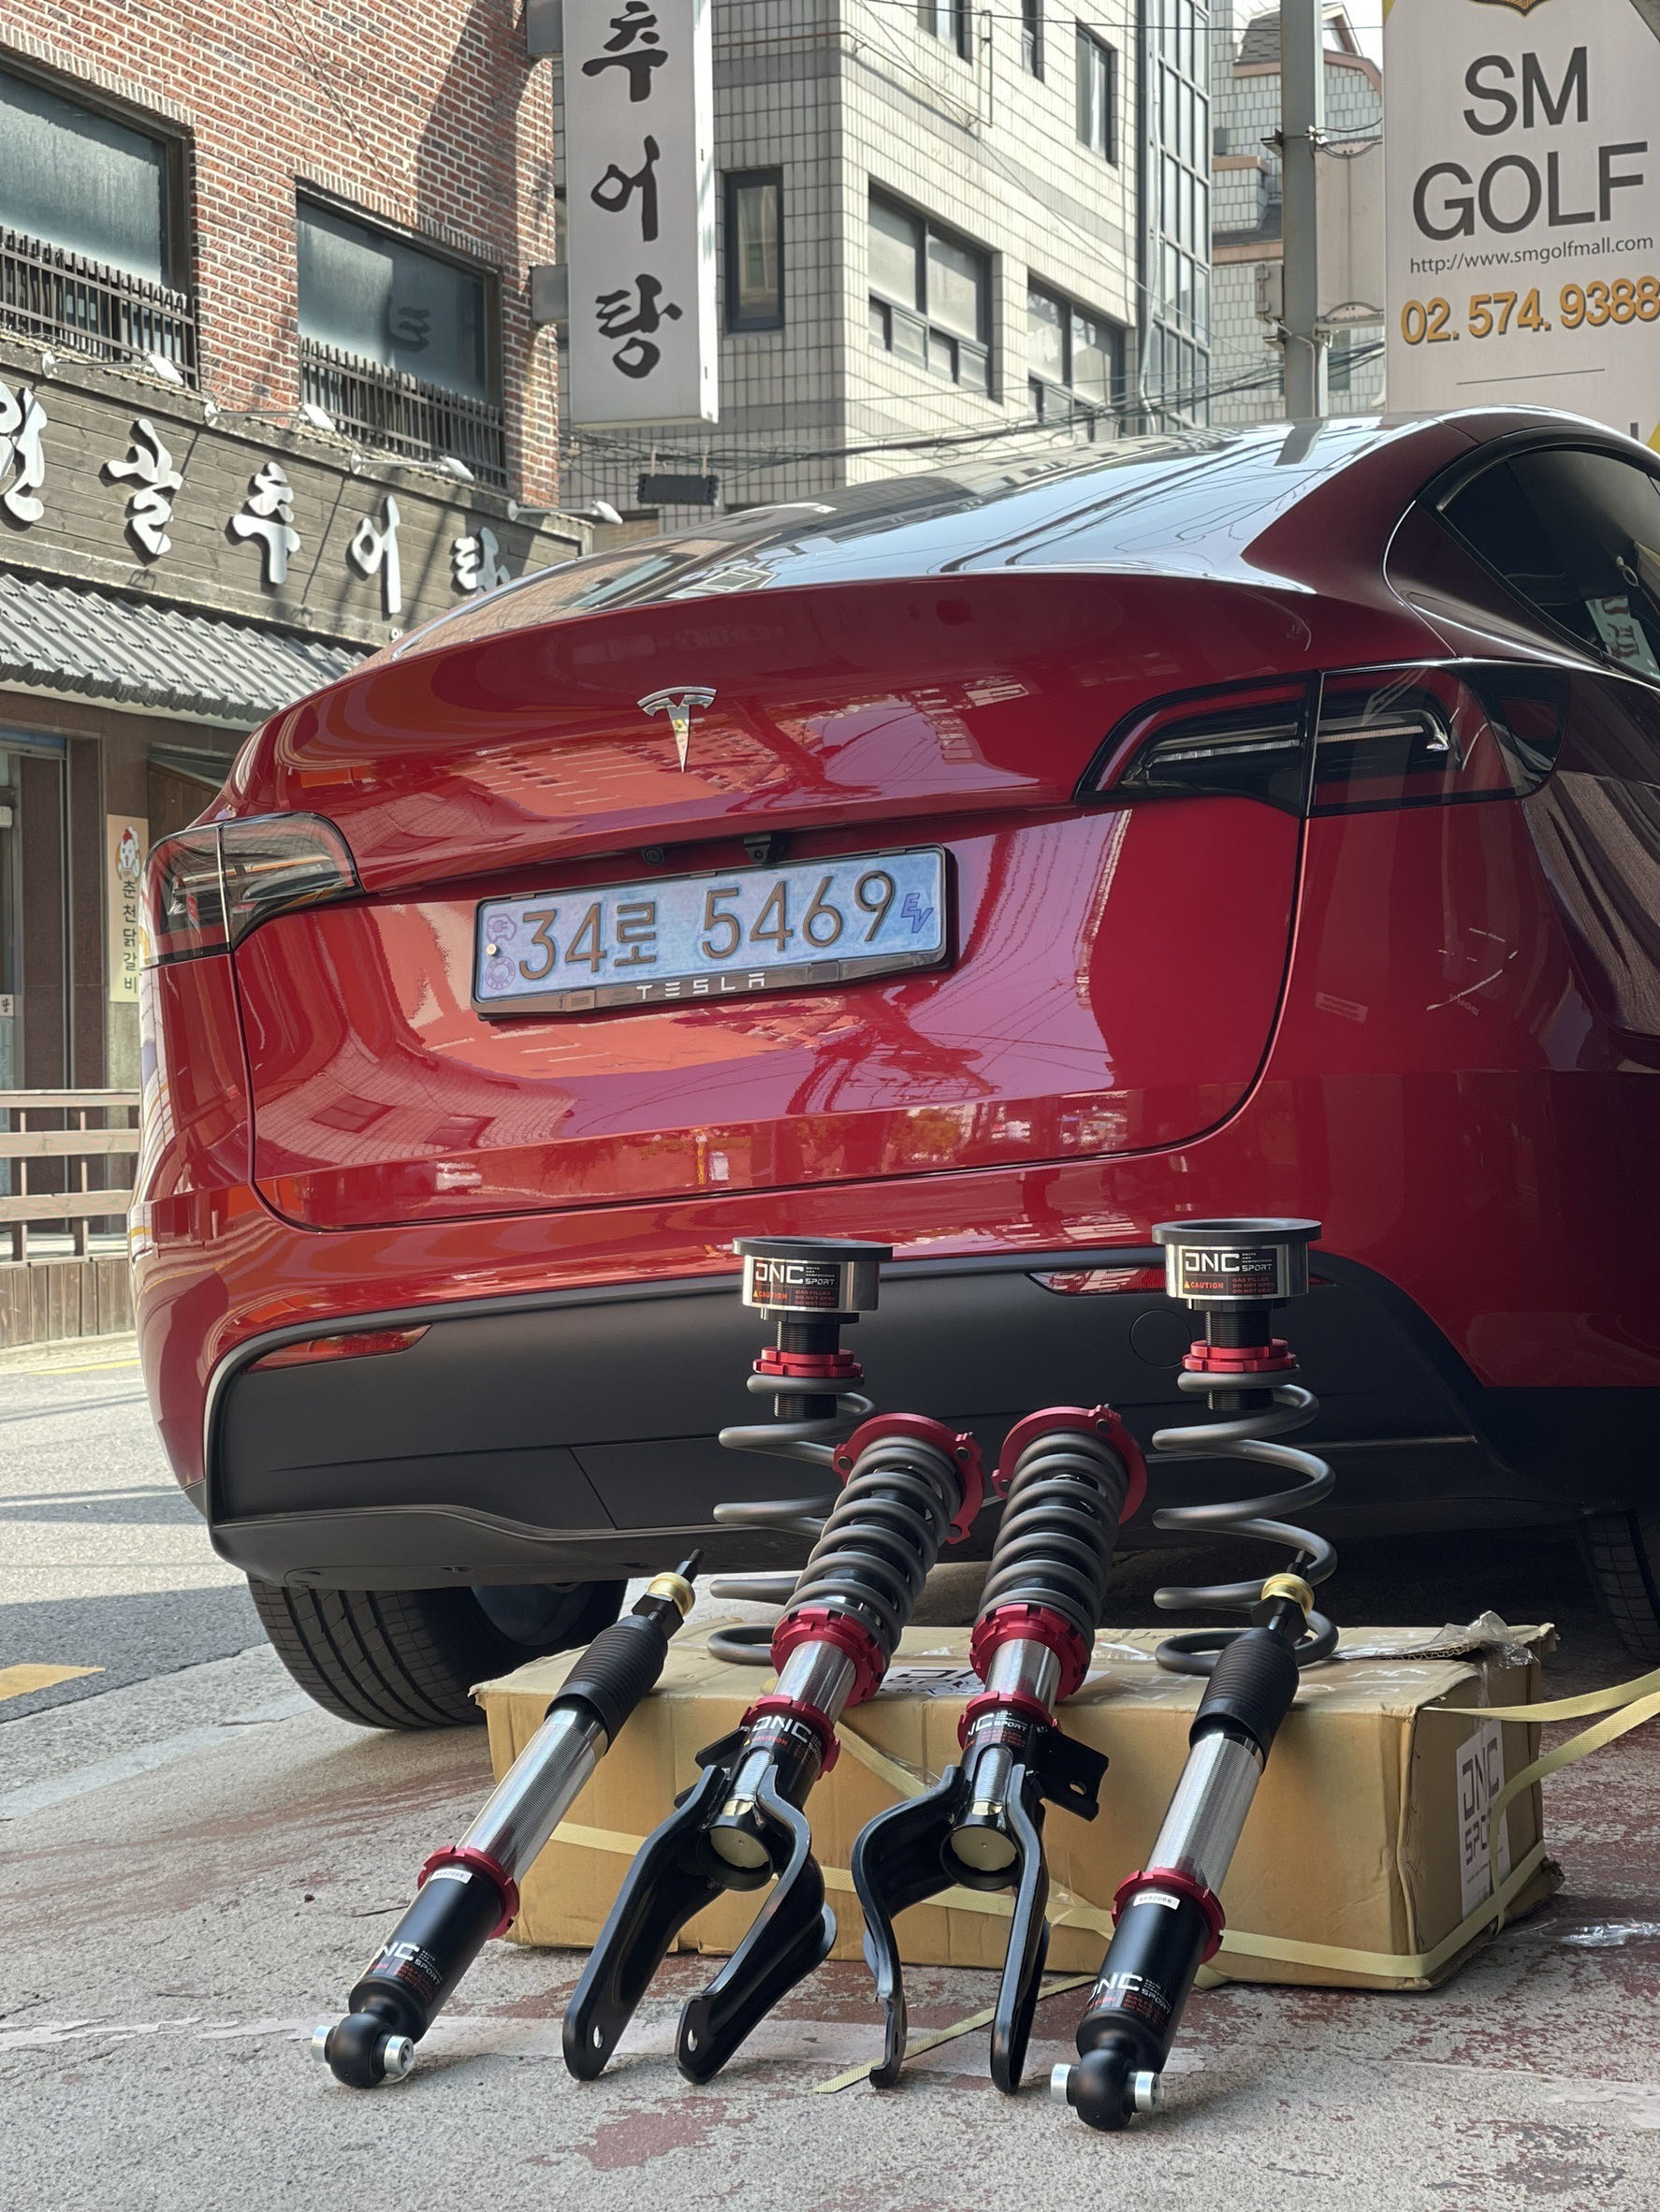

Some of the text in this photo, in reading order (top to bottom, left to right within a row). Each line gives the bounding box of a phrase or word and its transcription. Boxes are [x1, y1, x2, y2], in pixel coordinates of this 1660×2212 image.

[1463, 46, 1588, 136] SM
[582, 1, 683, 378] 추어탕
[1413, 141, 1648, 241] GOLF
[1410, 234, 1653, 274] http://www.smgolfmall.com
[123, 880, 138, 994] 춘천닭갈비
[701, 869, 896, 960] 5469
[901, 892, 934, 934] EV
[635, 973, 765, 1000] TESLA
[415, 1957, 442, 1985] SPORT
[1142, 1988, 1172, 2014] SPORT
